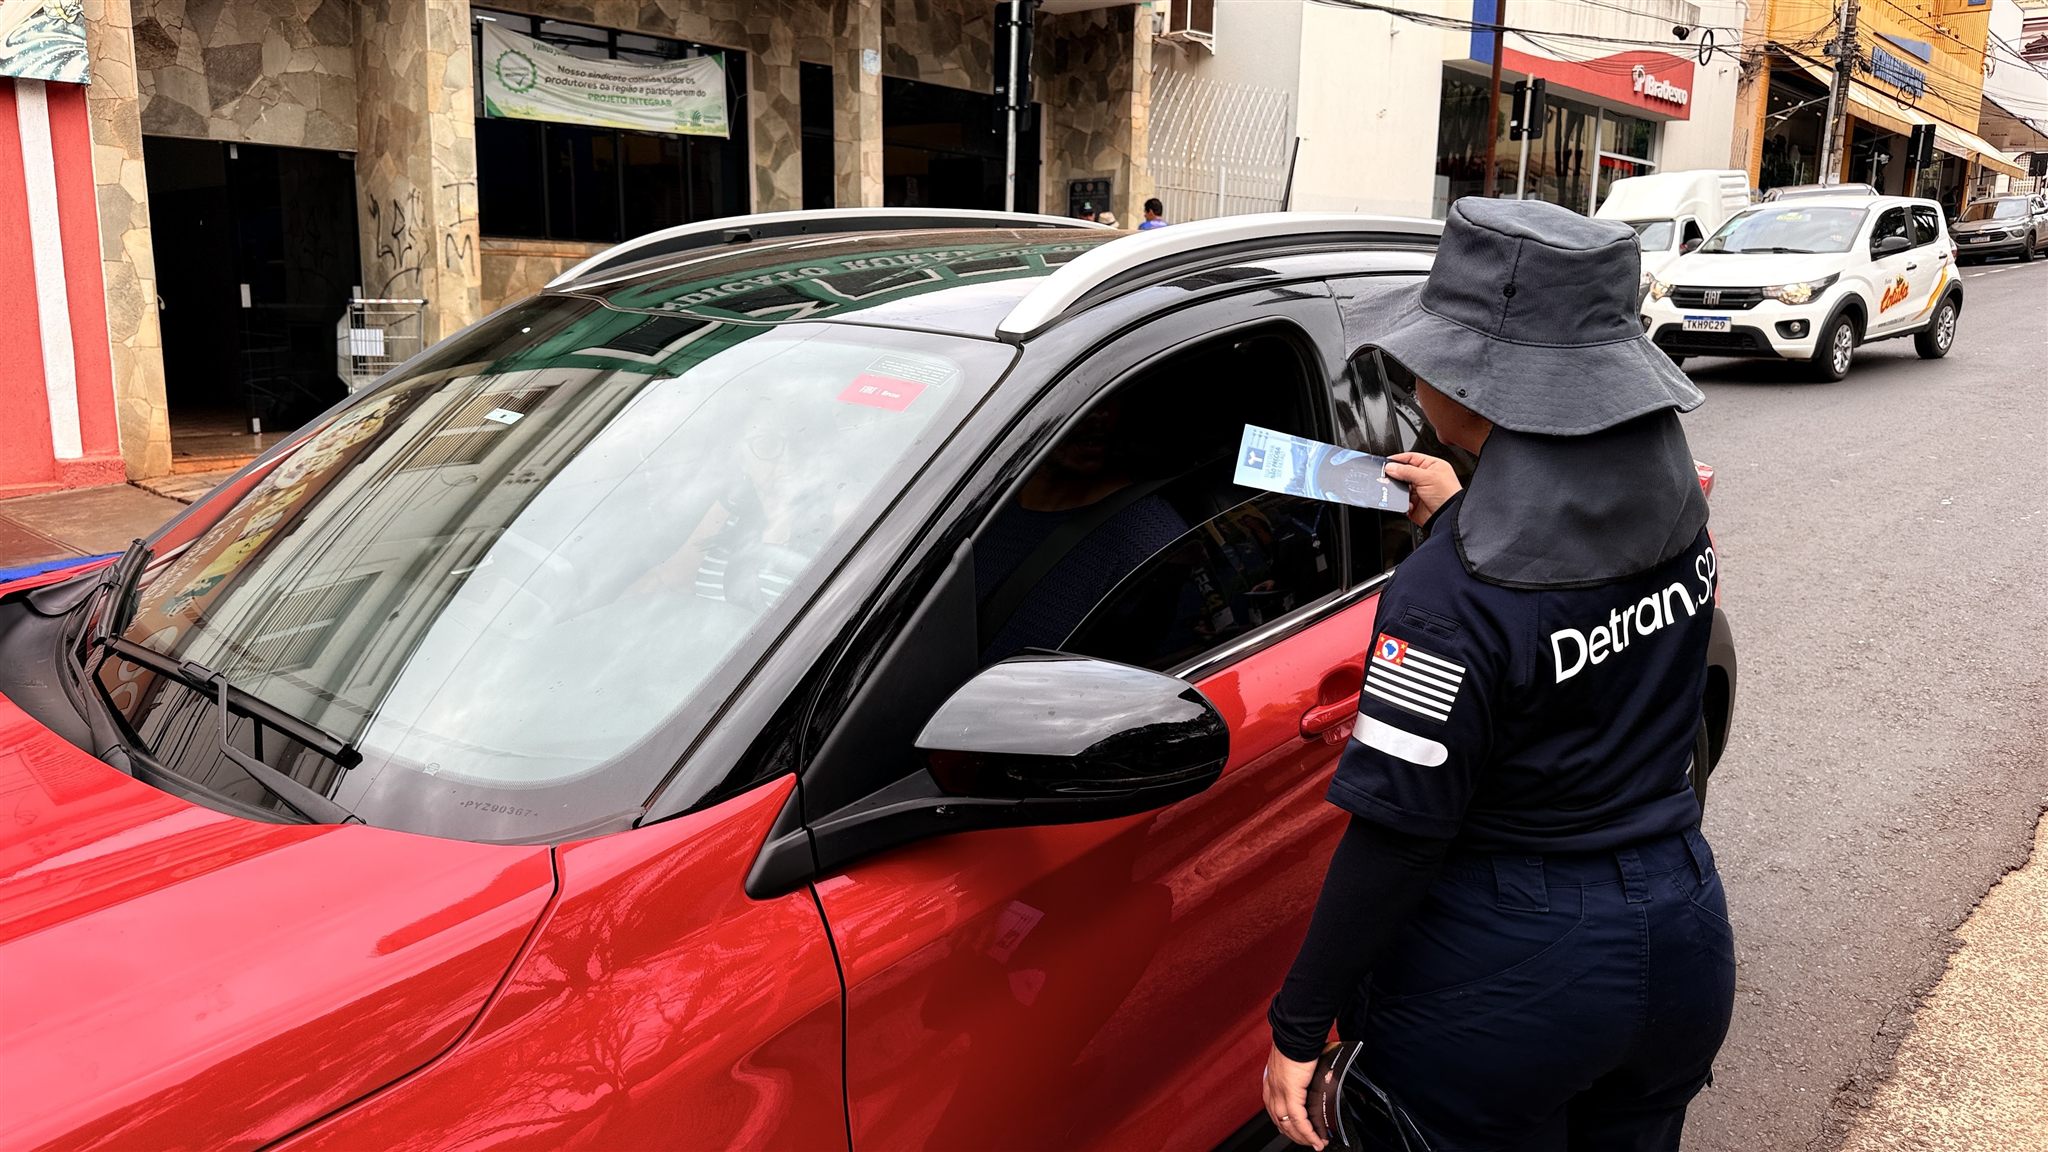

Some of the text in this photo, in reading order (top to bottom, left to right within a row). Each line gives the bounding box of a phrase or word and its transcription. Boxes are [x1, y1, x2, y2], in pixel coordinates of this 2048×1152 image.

[557, 65, 587, 78] Nosso
[544, 76, 598, 90] produtores
[611, 85, 638, 95] região
[645, 88, 696, 98] participarem
[1644, 74, 1689, 106] Bradesco
[587, 93, 673, 107] PROJETO INTEGRAR
[1702, 290, 1722, 305] FIAT
[1687, 320, 1726, 331] TKH9C29
[1550, 545, 1717, 685] Detran.SP
